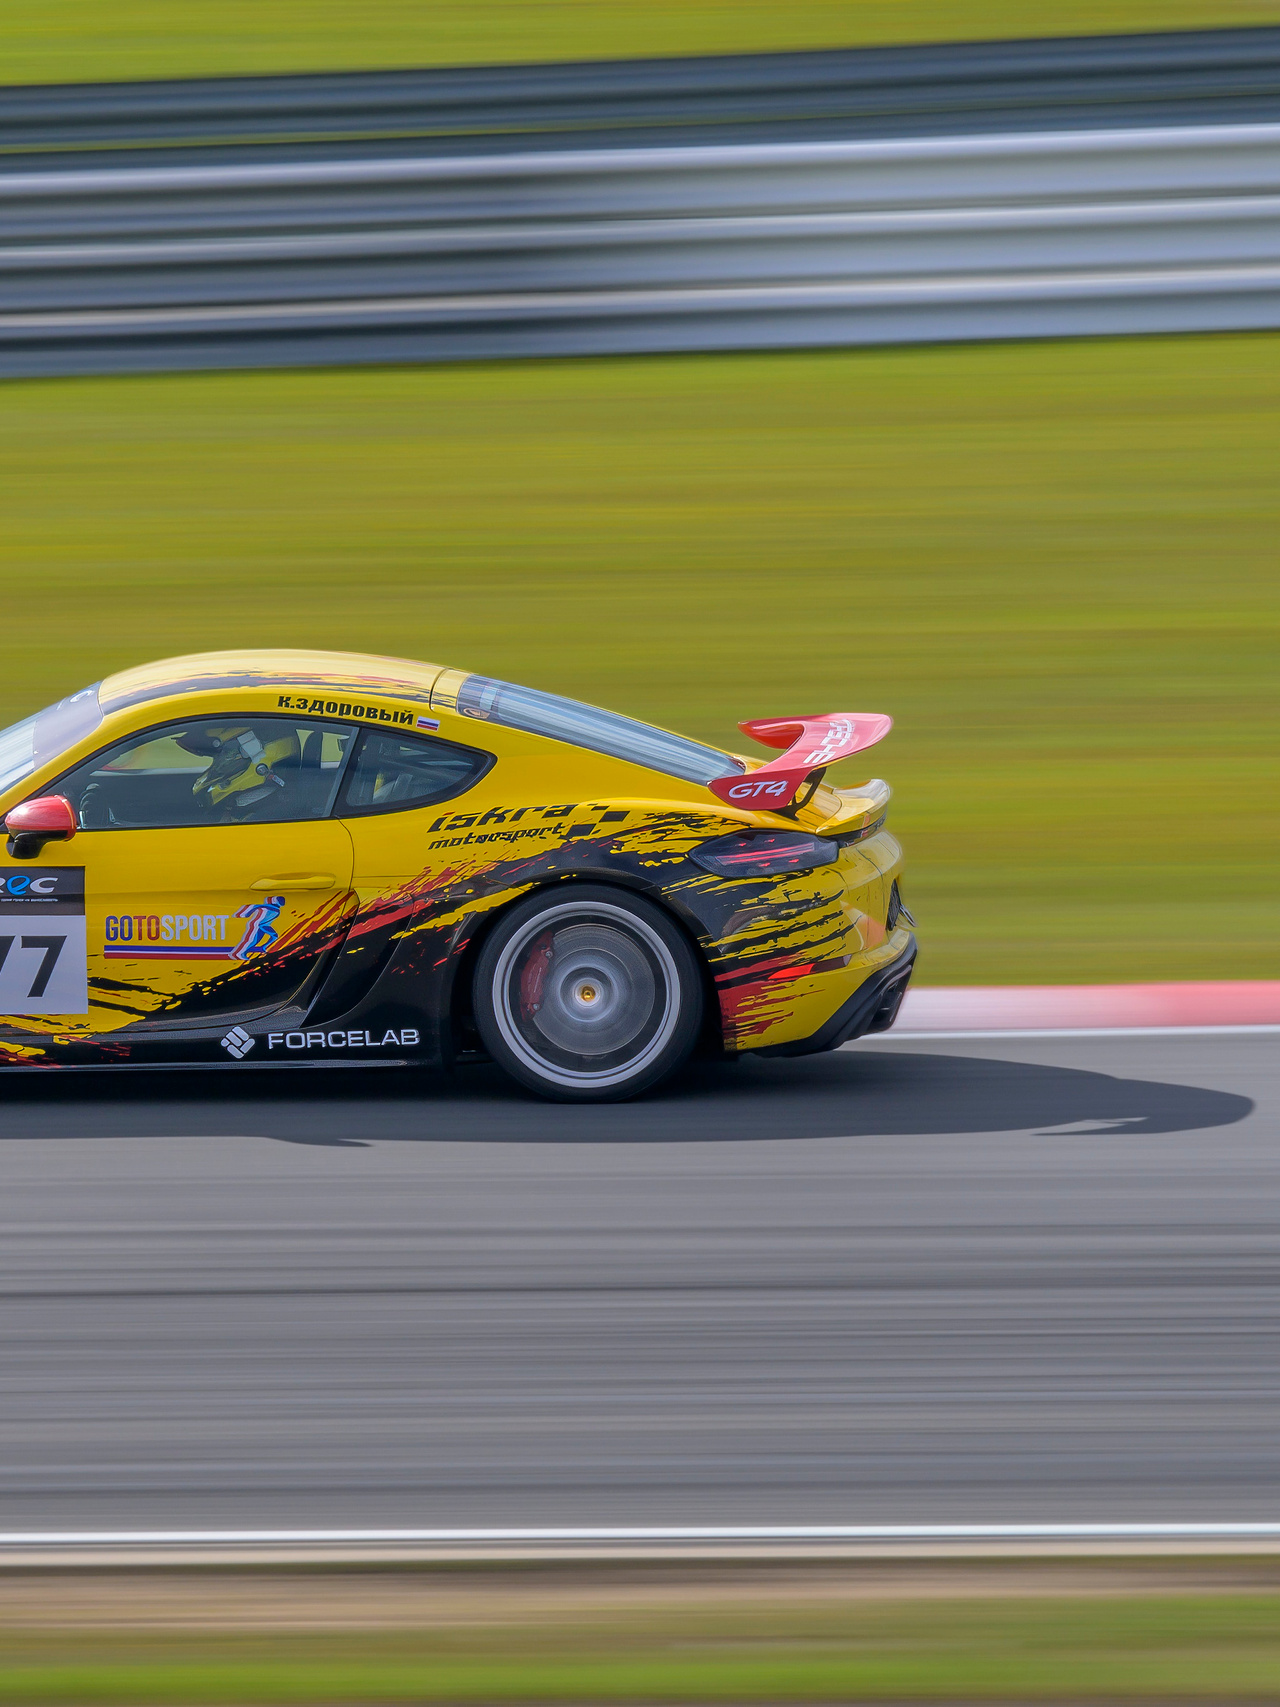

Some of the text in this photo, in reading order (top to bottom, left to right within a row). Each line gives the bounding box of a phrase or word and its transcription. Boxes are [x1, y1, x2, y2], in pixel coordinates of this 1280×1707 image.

[728, 780, 789, 798] GT4
[427, 822, 568, 851] motorsport
[105, 914, 229, 942] GOTOSPORT
[267, 1028, 420, 1050] FORCELAB
